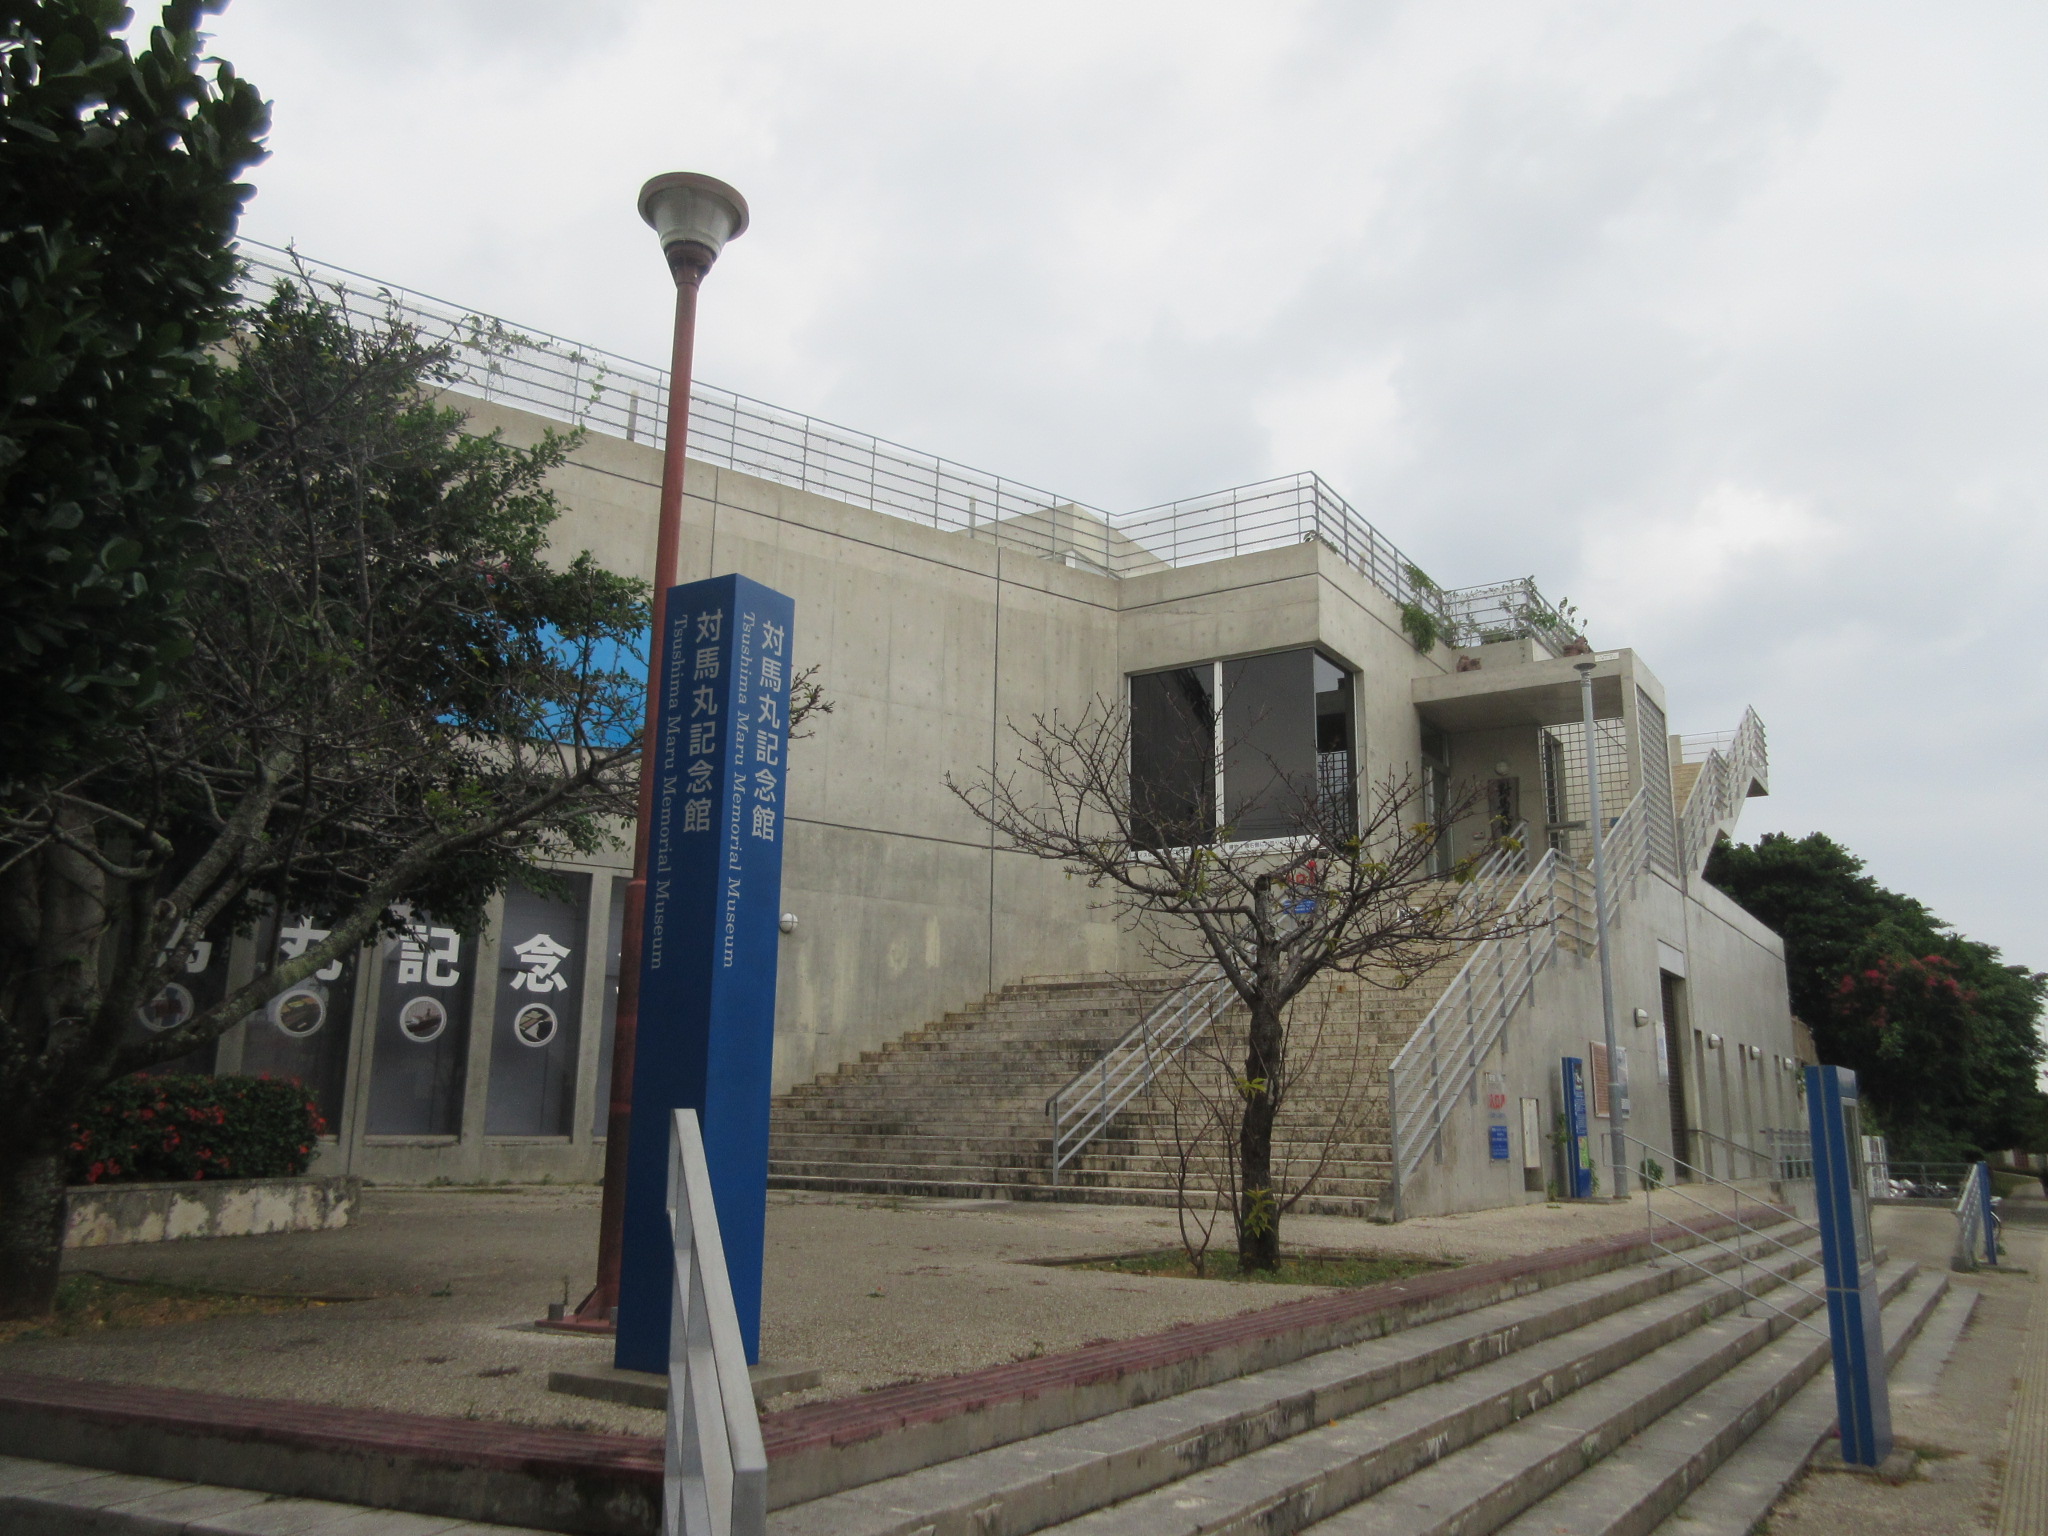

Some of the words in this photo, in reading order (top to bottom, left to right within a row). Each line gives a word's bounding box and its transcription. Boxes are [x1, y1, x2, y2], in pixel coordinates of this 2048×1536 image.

[668, 614, 688, 710] Tsushima
[738, 611, 756, 704] Tsushima
[664, 714, 681, 770] Maru
[683, 608, 723, 832] 対馬丸記念館
[734, 710, 750, 766] Maru
[751, 620, 784, 842] 対馬丸記念館
[657, 775, 677, 874] Memorial
[728, 771, 747, 871] Memorial
[651, 879, 671, 970] Museum
[723, 876, 741, 968] Museum
